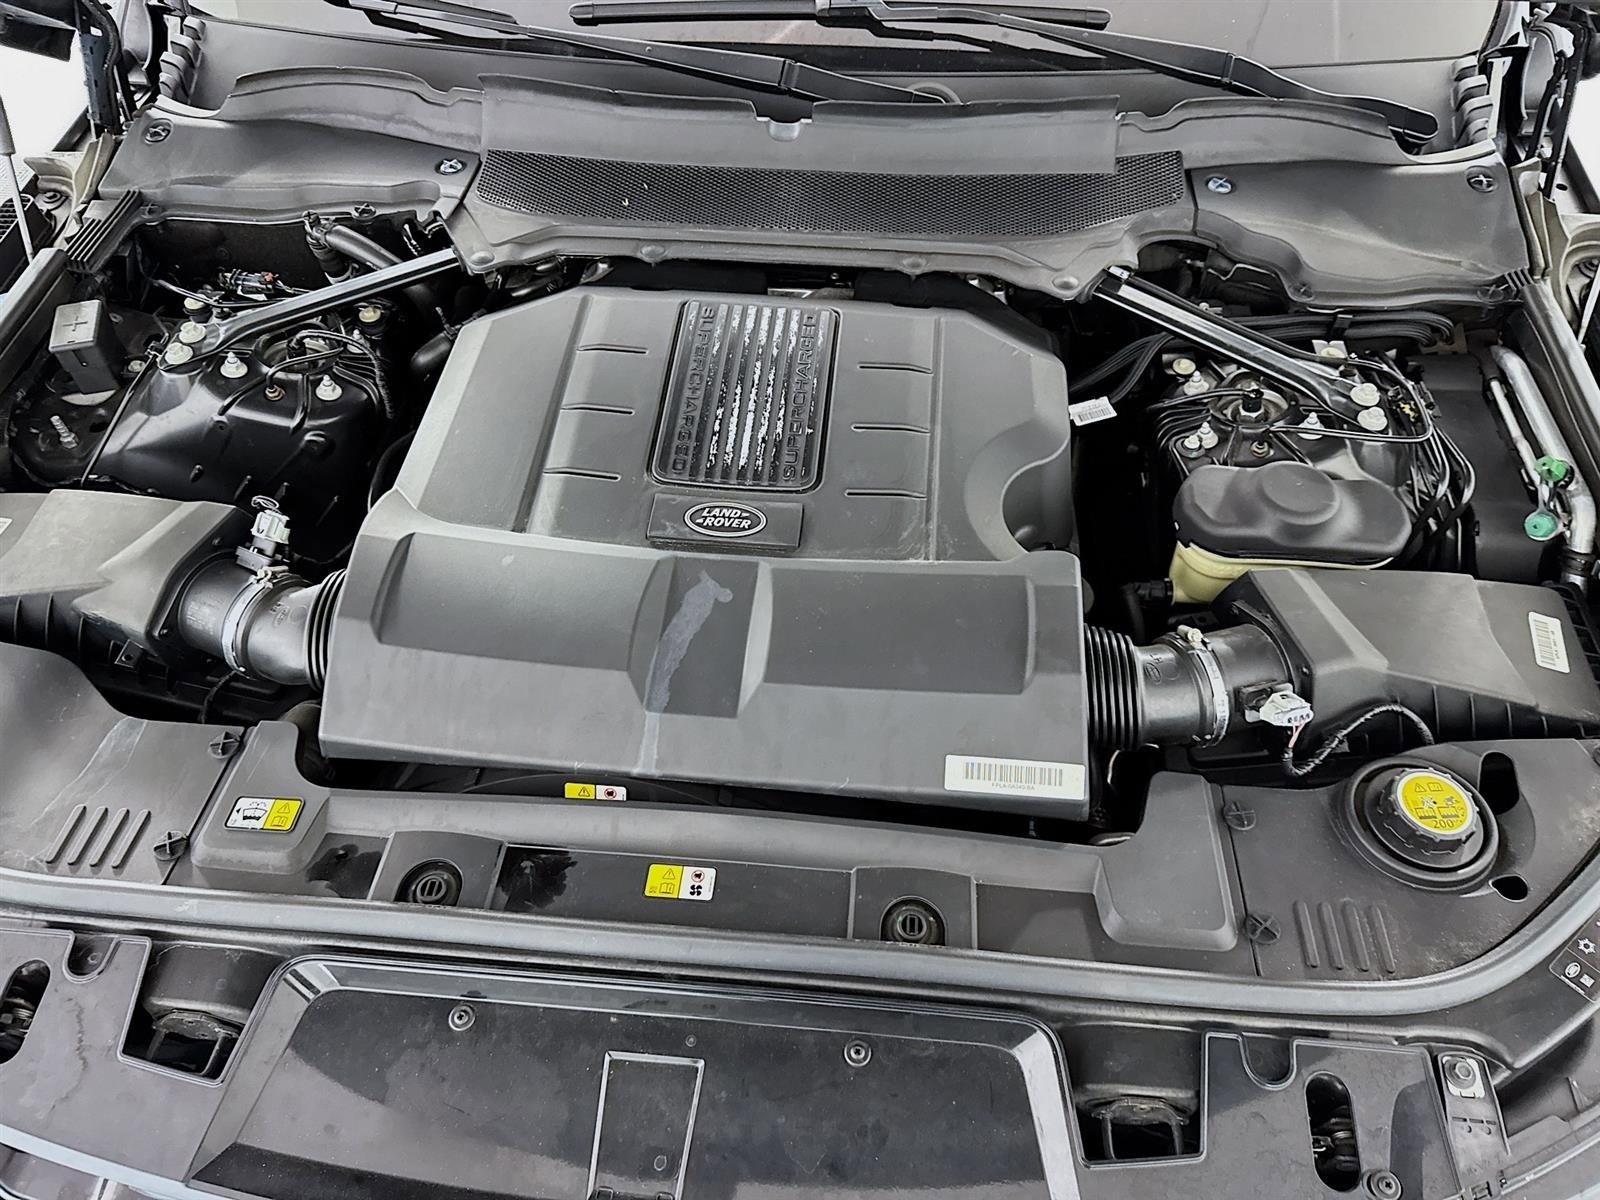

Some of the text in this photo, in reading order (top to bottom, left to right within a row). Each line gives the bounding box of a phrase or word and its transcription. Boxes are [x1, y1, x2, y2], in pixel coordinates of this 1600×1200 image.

[671, 306, 715, 476] SUPERCHARGED
[783, 314, 817, 481] SUPERCHARGED
[702, 507, 741, 517] LAND
[703, 517, 752, 529] ROVER
